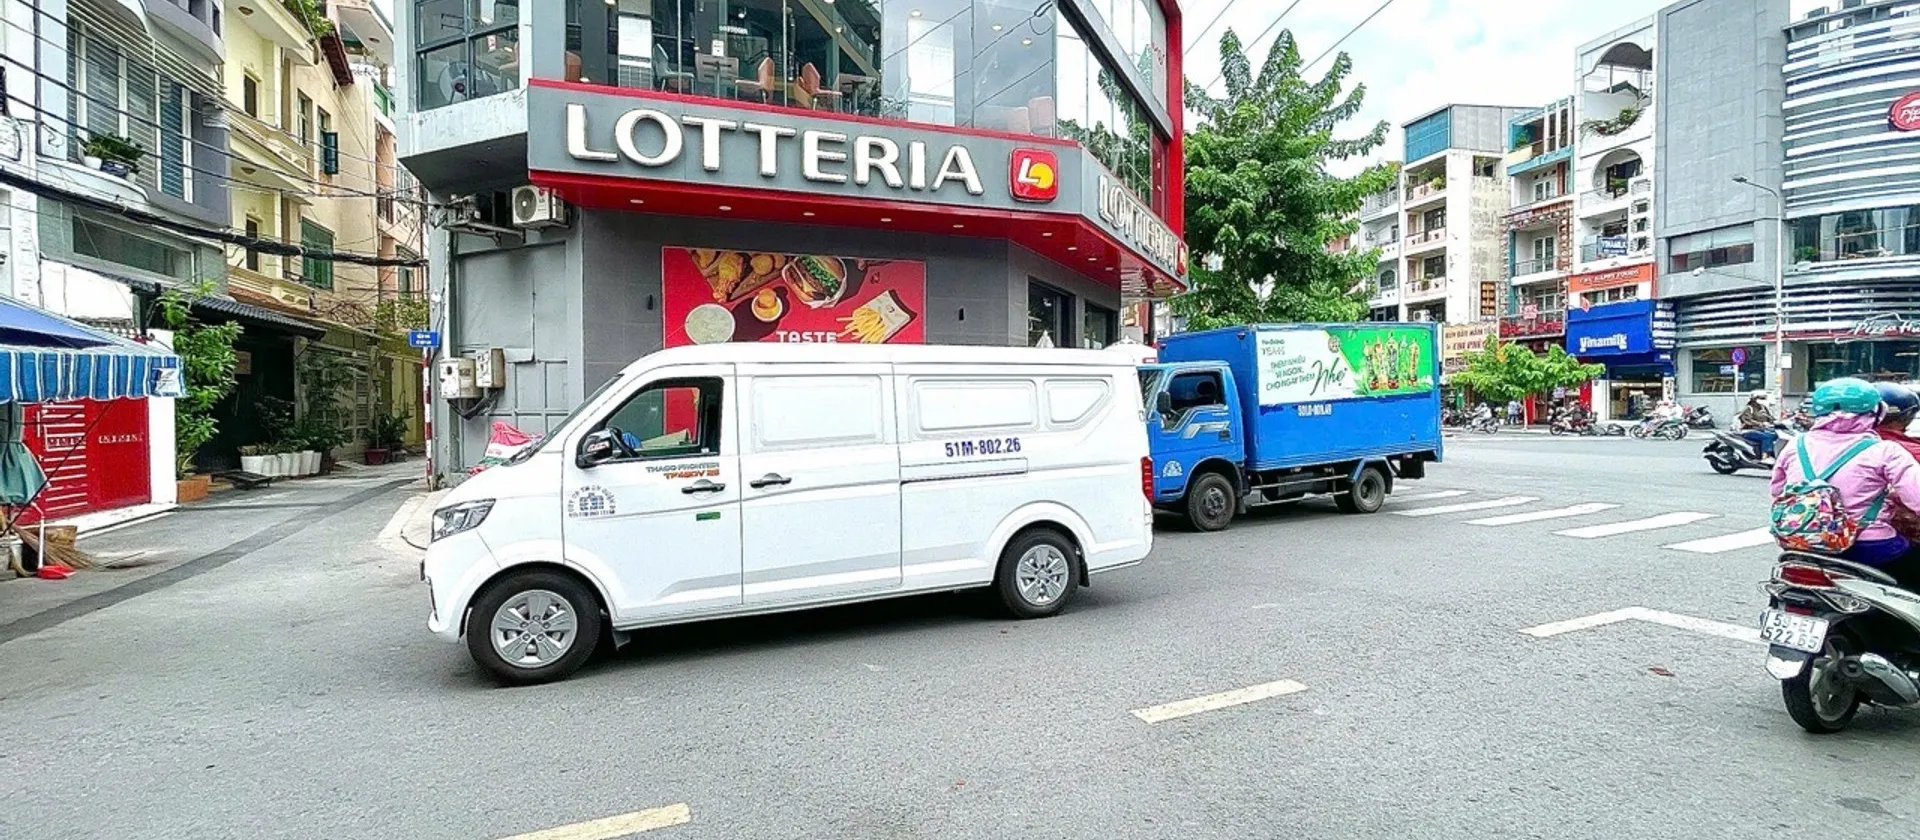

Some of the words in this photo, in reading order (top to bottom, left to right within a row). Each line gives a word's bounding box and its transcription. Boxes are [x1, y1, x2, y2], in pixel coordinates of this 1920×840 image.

[566, 103, 984, 195] LOTTERIA
[1098, 174, 1174, 269] LOTTERIA
[776, 331, 837, 343] TASTE
[1579, 333, 1628, 352] Vinamilk
[945, 437, 1021, 457] 51M-802.26
